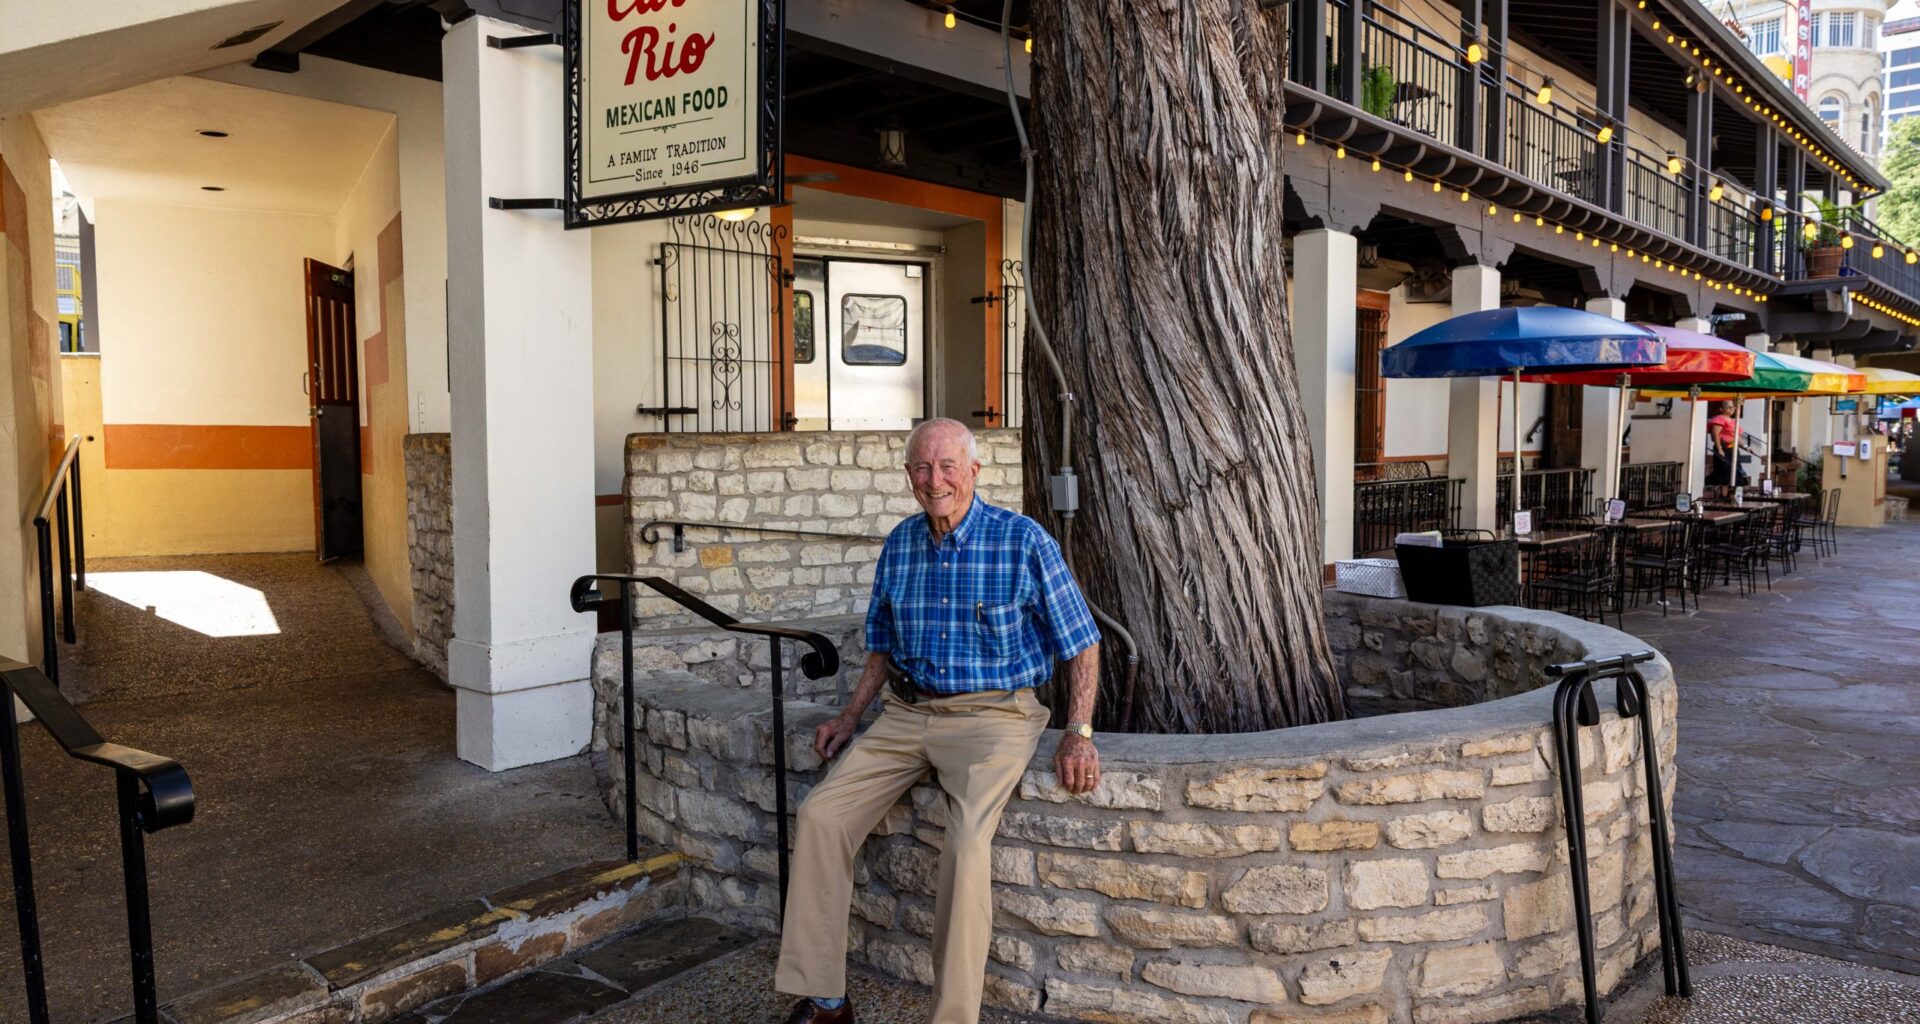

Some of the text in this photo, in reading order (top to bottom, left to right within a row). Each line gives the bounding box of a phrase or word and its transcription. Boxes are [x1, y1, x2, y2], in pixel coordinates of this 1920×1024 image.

[1798, 0, 1809, 61] ASA
[621, 23, 715, 86] Rio
[606, 86, 728, 128] MEXICAN FOOD
[607, 136, 726, 168] A FAMILY TRADITION
[635, 160, 699, 181] Since 1946
